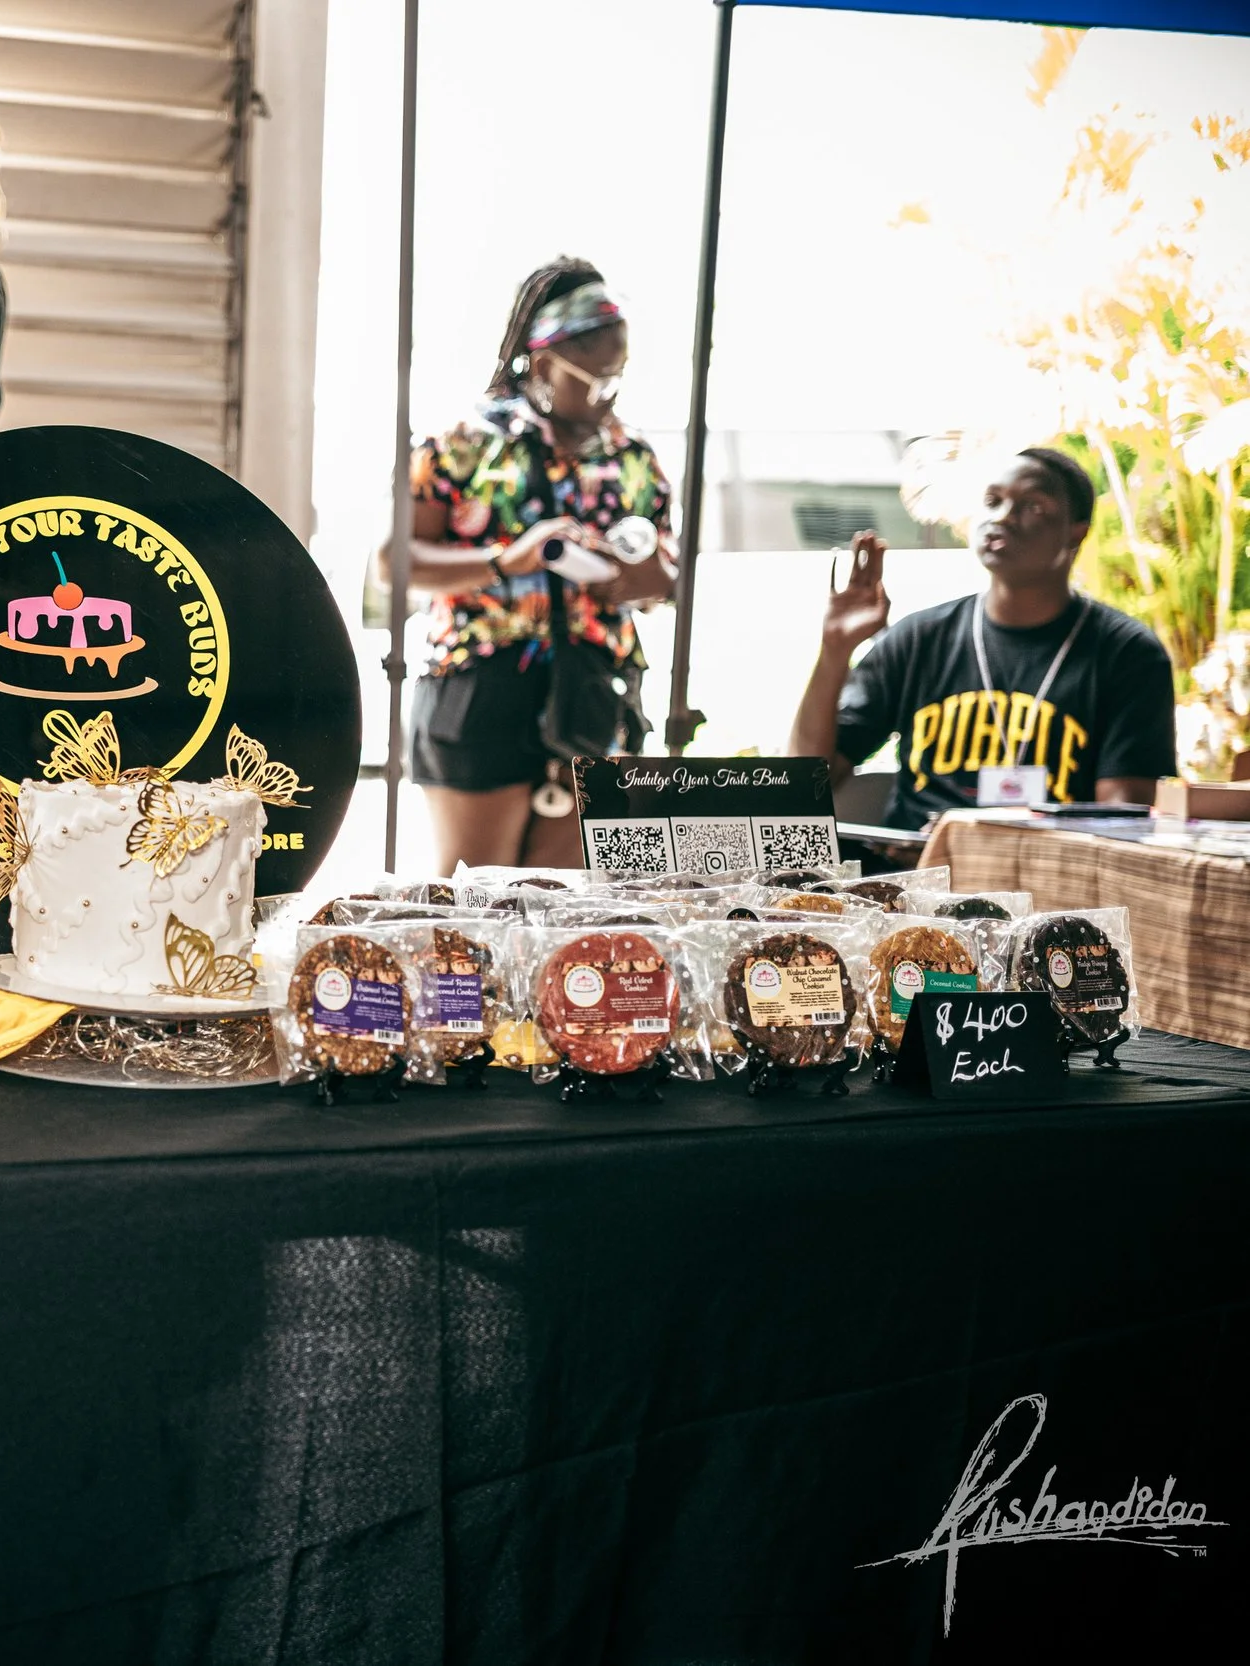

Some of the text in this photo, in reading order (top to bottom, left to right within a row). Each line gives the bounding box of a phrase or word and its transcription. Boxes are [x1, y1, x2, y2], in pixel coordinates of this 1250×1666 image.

[94, 514, 194, 593] TASTE
[179, 600, 219, 698] BUDS
[616, 767, 790, 793] Indulge Your Taste Buds
[262, 832, 305, 851] ORE
[465, 887, 489, 904] Thank
[787, 966, 838, 976] Walnut Chocolate
[792, 974, 832, 986] Chip Caramel
[802, 981, 825, 990] Cookies
[929, 978, 972, 990] Coconut Cookies
[951, 1048, 1026, 1083] Each
